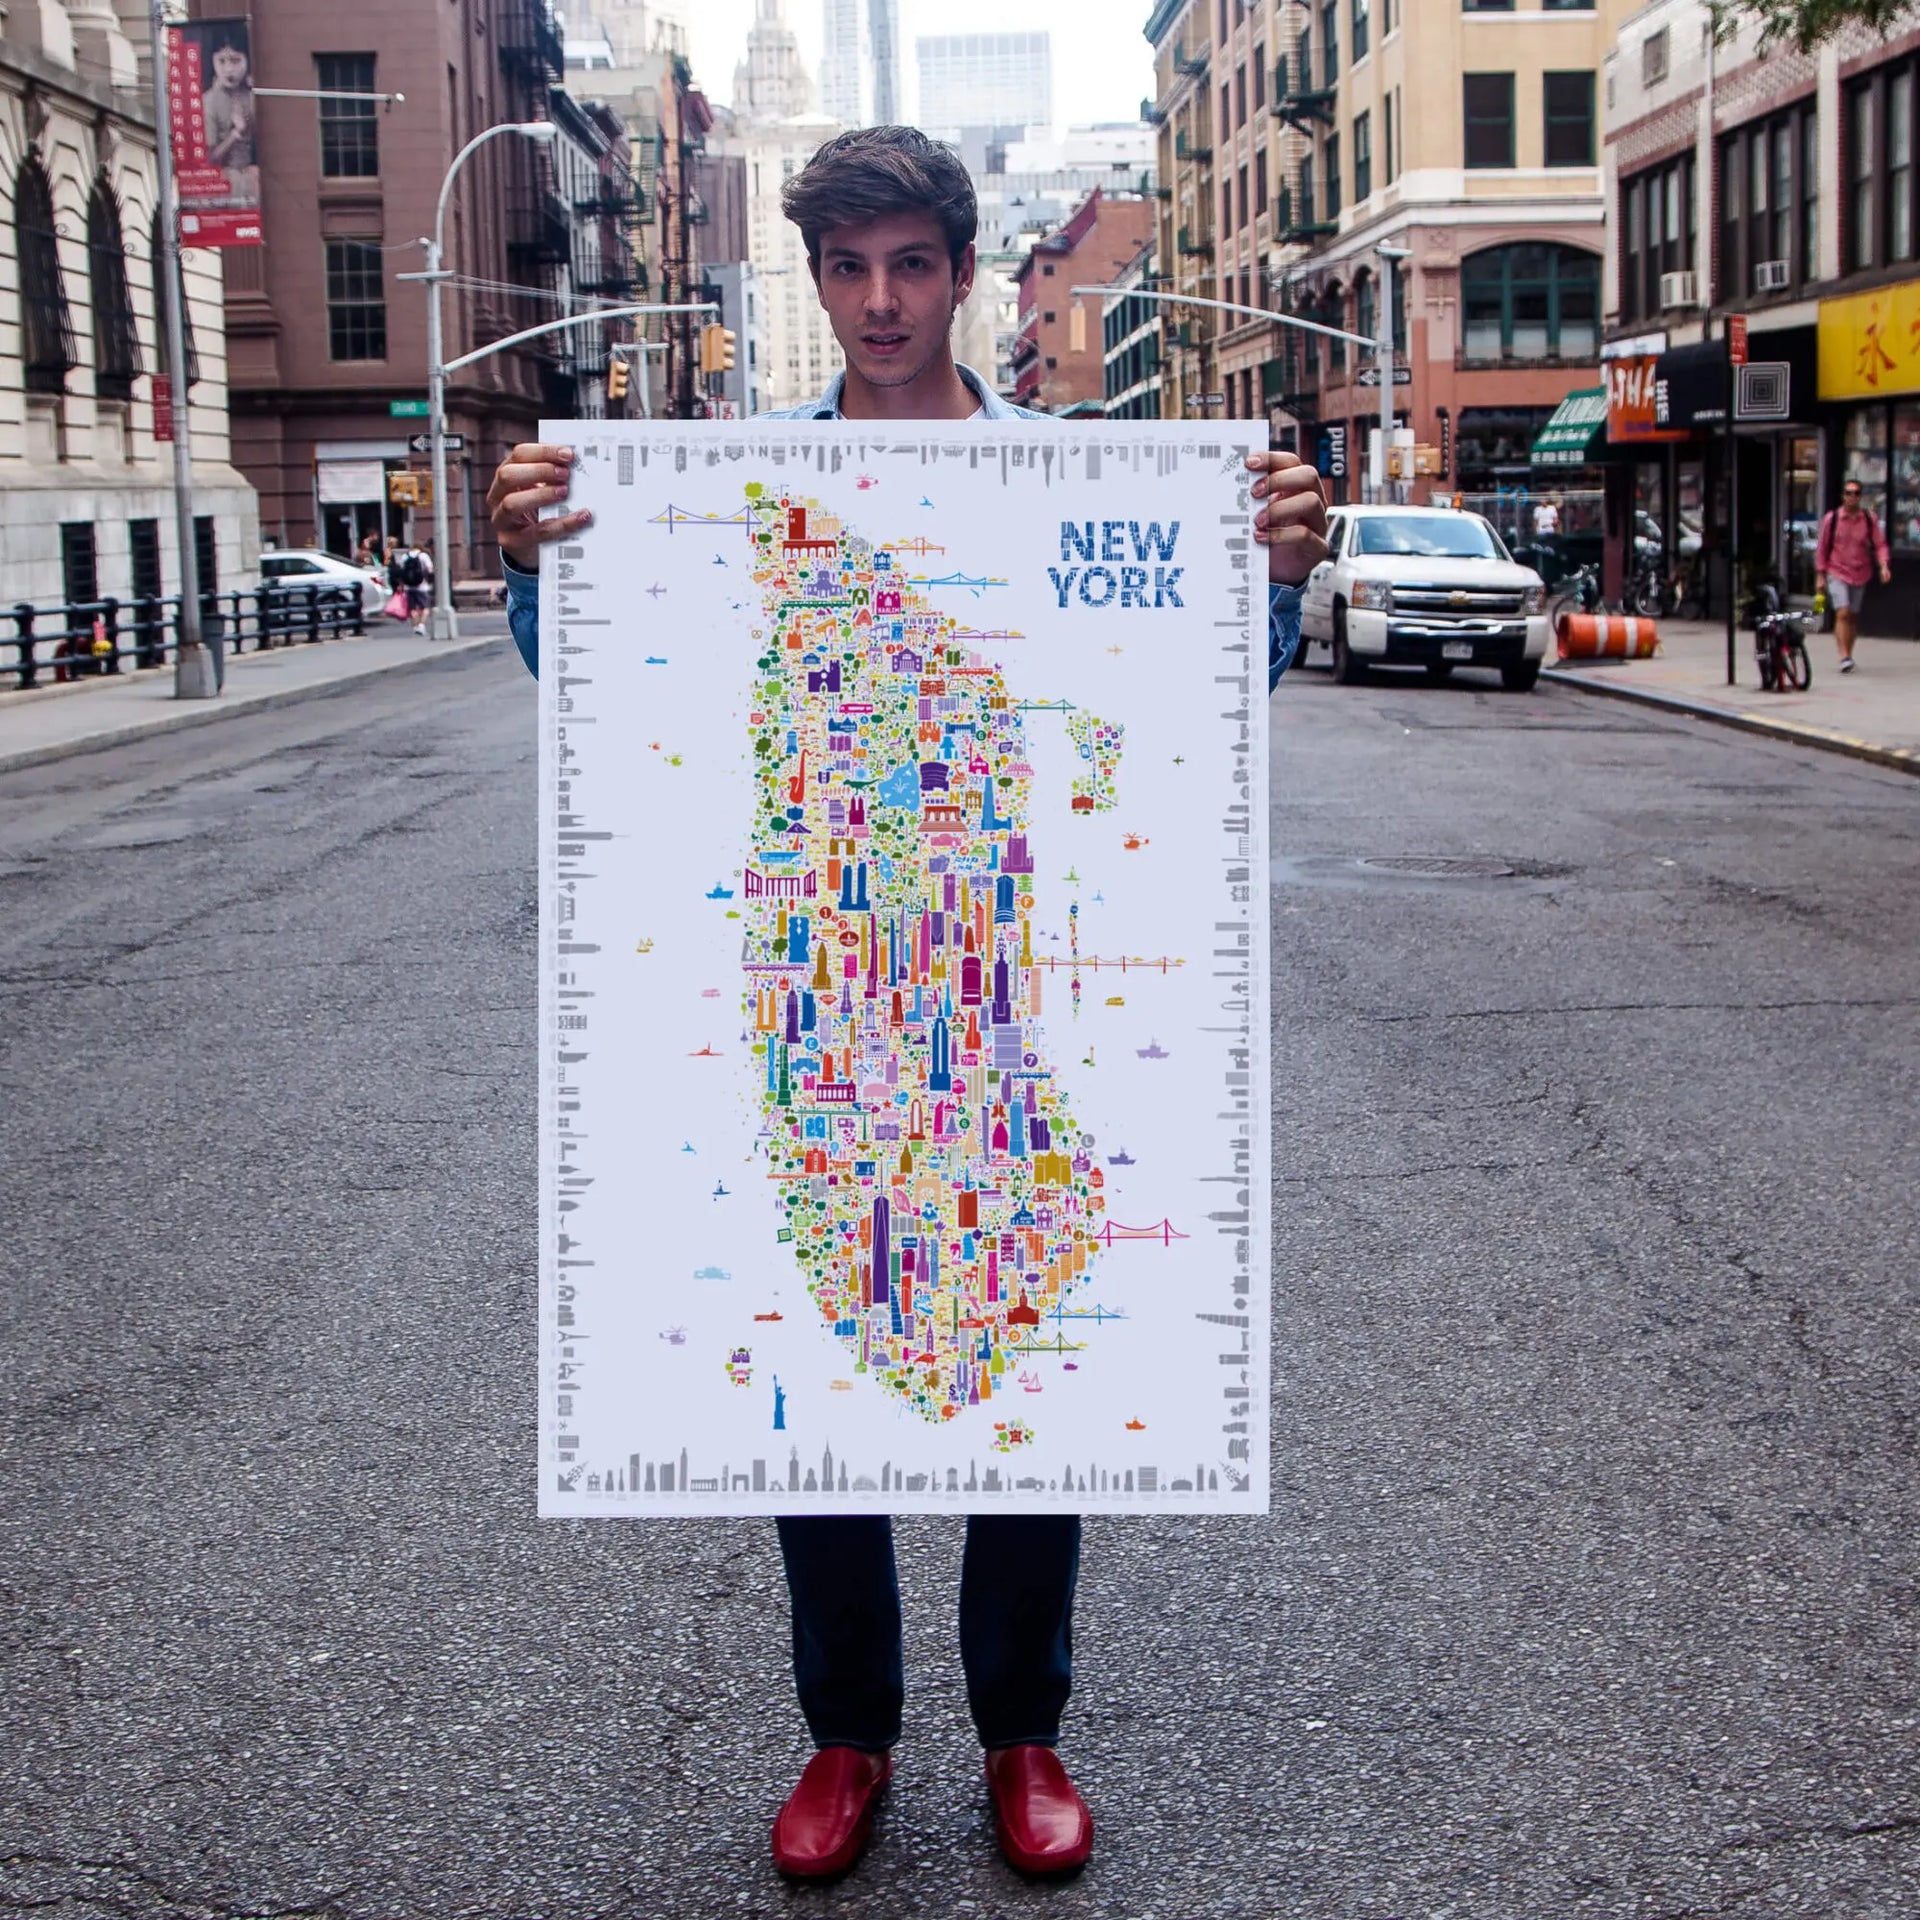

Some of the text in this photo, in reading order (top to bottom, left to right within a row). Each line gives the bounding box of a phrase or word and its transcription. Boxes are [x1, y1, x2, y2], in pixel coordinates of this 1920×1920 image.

[1326, 427, 1345, 476] puro
[1061, 520, 1180, 561] NEW
[1047, 566, 1184, 608] YORK
